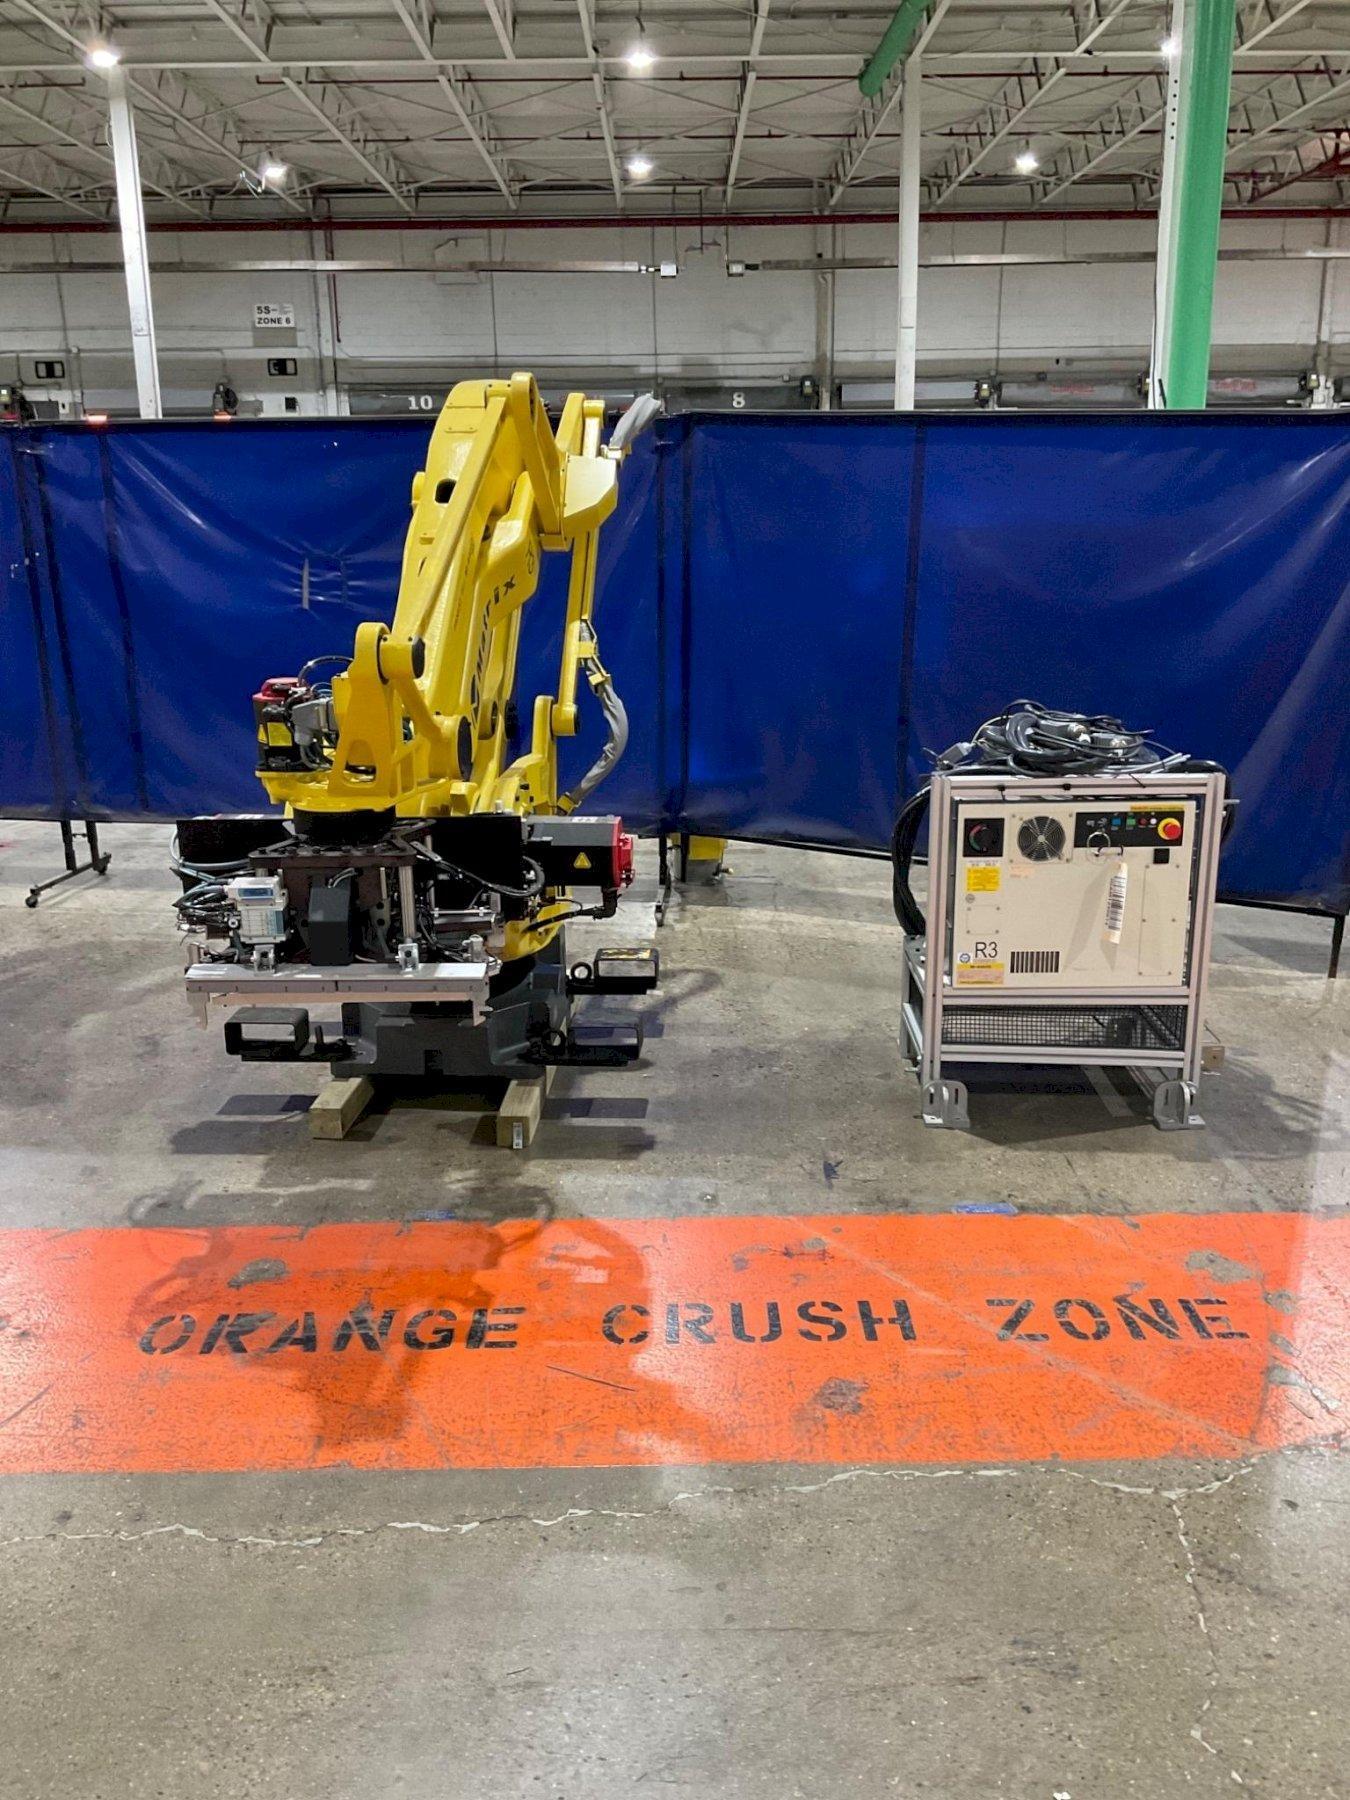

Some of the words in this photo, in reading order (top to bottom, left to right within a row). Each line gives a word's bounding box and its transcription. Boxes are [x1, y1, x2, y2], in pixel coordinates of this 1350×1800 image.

[257, 317, 282, 325] ZONE
[408, 395, 433, 410] 10
[732, 391, 746, 408] 8
[974, 941, 998, 959] R3
[138, 1306, 527, 1355] ORANGE
[602, 1299, 917, 1345] CRUSH
[985, 1297, 1251, 1341] ZONE
